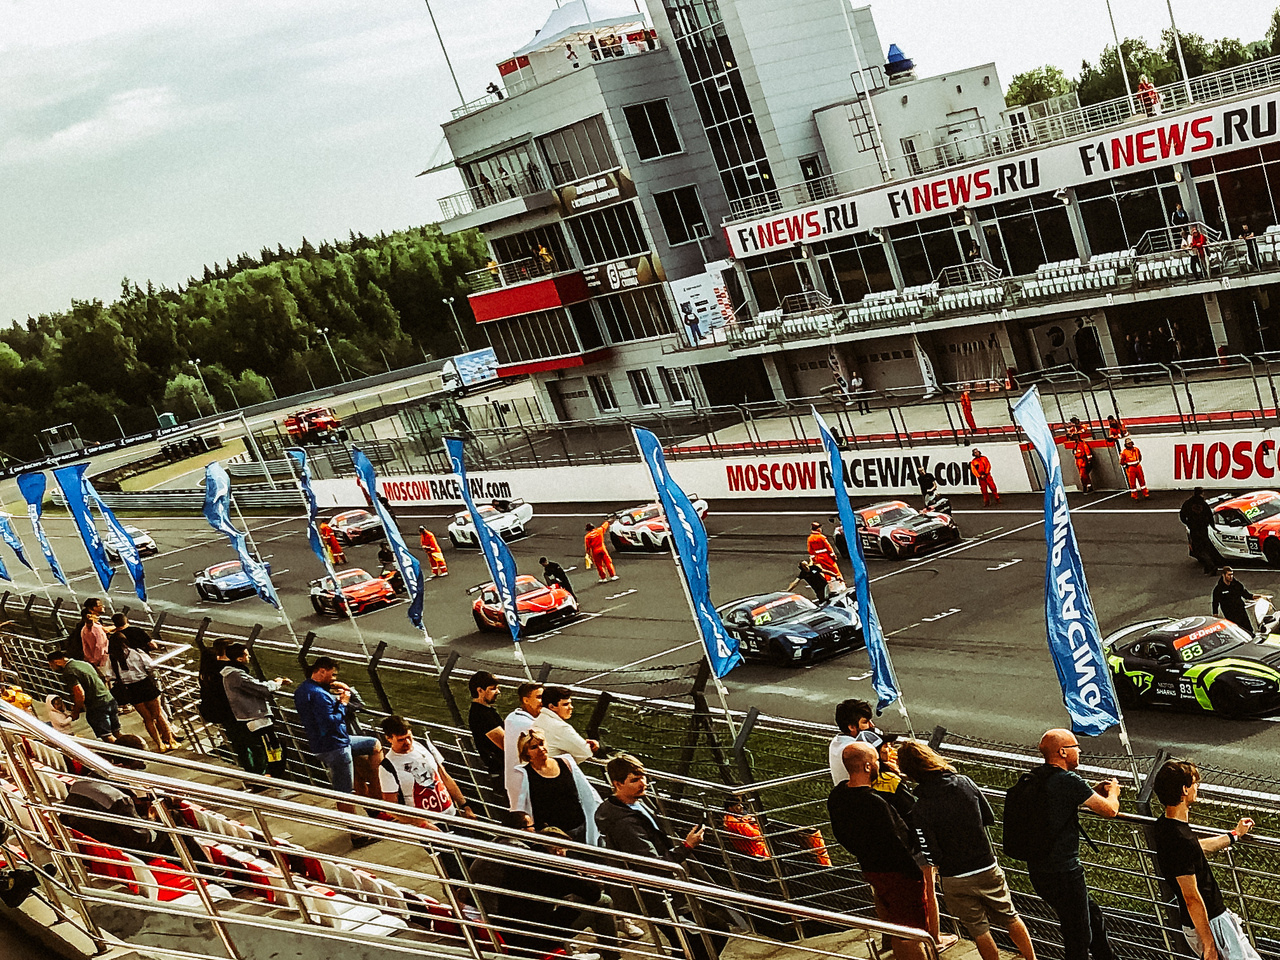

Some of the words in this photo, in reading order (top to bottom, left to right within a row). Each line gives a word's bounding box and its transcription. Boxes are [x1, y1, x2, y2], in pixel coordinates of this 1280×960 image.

[1078, 100, 1278, 177] F1NEWS.RU
[886, 157, 1041, 219] F1NEWS.RU
[737, 201, 859, 253] F1NEWS.RU
[726, 455, 978, 493] MOSCOWRCEWAYcom
[1181, 644, 1203, 661] 83
[1156, 688, 1177, 697] SHARKS
[1179, 683, 1192, 694] 83
